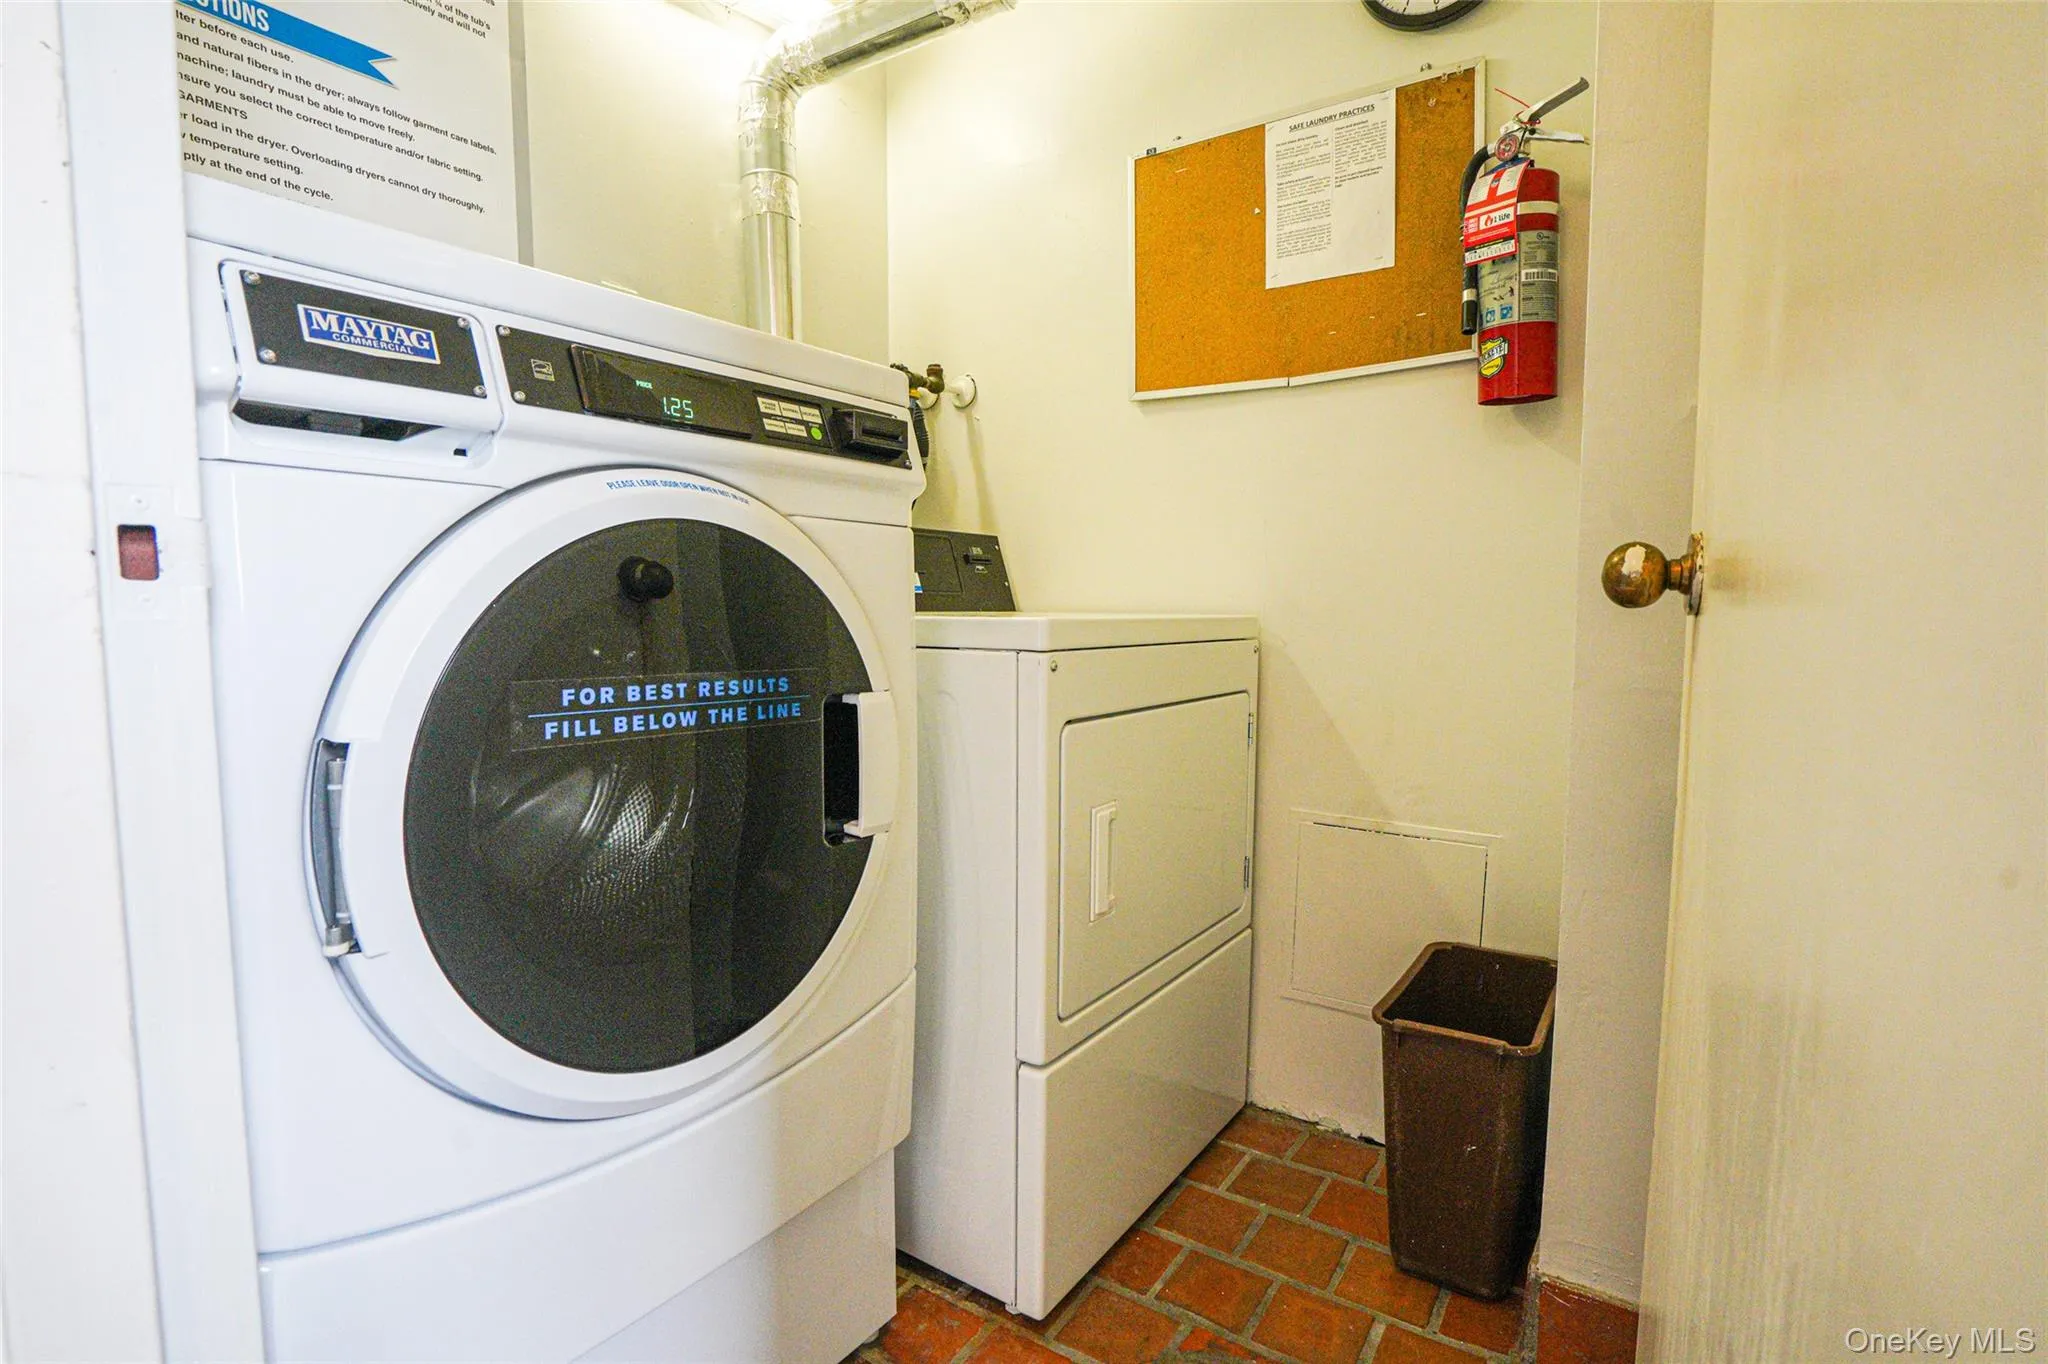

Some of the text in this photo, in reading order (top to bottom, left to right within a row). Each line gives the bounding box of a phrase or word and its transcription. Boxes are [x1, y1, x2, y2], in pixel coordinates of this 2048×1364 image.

[438, 11, 454, 24] and
[456, 20, 471, 31] will
[472, 28, 486, 38] not
[444, 5, 491, 30] of the tub's
[199, 19, 238, 41] before
[240, 36, 268, 53] each
[270, 48, 294, 63] use.
[176, 31, 497, 155] and natural fibers in the dryer; always follow garment care labels.
[232, 69, 275, 94] laundry
[278, 87, 304, 103] must
[307, 96, 320, 108] be
[322, 104, 345, 117] able
[346, 111, 357, 121] to
[359, 116, 386, 131] move
[388, 125, 415, 142] freely.
[214, 84, 236, 97] you
[240, 92, 274, 110] select
[276, 104, 293, 116] the
[296, 112, 332, 130] correct
[335, 125, 393, 151] temperature
[395, 145, 424, 160] and/or
[426, 155, 452, 170] fabric
[453, 166, 484, 182] setting.
[1288, 122, 1304, 131] SAFE
[1305, 114, 1337, 128] LAUNDRY
[1338, 104, 1376, 118] PRACTICES
[190, 132, 304, 175] temperature setting.
[191, 113, 218, 130] load
[221, 122, 232, 134] in
[235, 128, 254, 140] the
[256, 135, 288, 152] dryer.
[290, 145, 353, 174] Overloading
[355, 166, 386, 182] dryers
[388, 177, 420, 193] cannot
[422, 187, 437, 200] dry
[438, 192, 486, 214] thoroughly.
[183, 152, 334, 201] ptly at the end of the cycle.
[307, 308, 430, 350] MAYTAG
[332, 332, 414, 356] COMMERCIAL
[663, 396, 694, 418] 1.25
[606, 480, 636, 490] PLEASE
[636, 480, 660, 488] LEAVE
[680, 482, 699, 491] OPEN
[562, 676, 790, 706] FOR BEST RESULTS
[544, 702, 802, 740] FILL BELOW THE LINE
